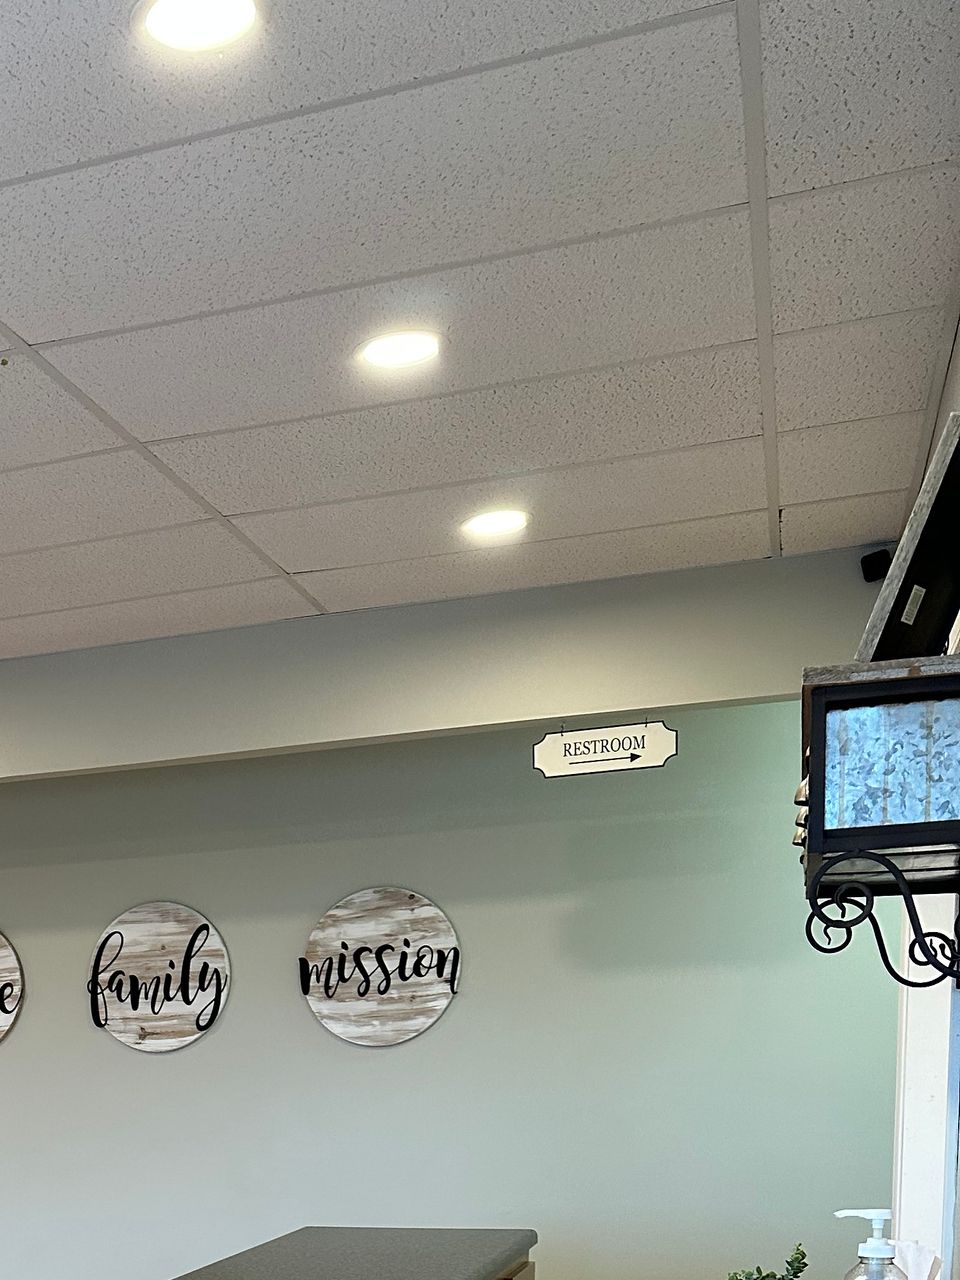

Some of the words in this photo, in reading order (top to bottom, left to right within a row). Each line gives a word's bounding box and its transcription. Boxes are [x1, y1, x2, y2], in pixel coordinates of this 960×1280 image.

[562, 735, 646, 757] RESTROOM
[87, 923, 229, 1032] family
[298, 937, 460, 998] mission
